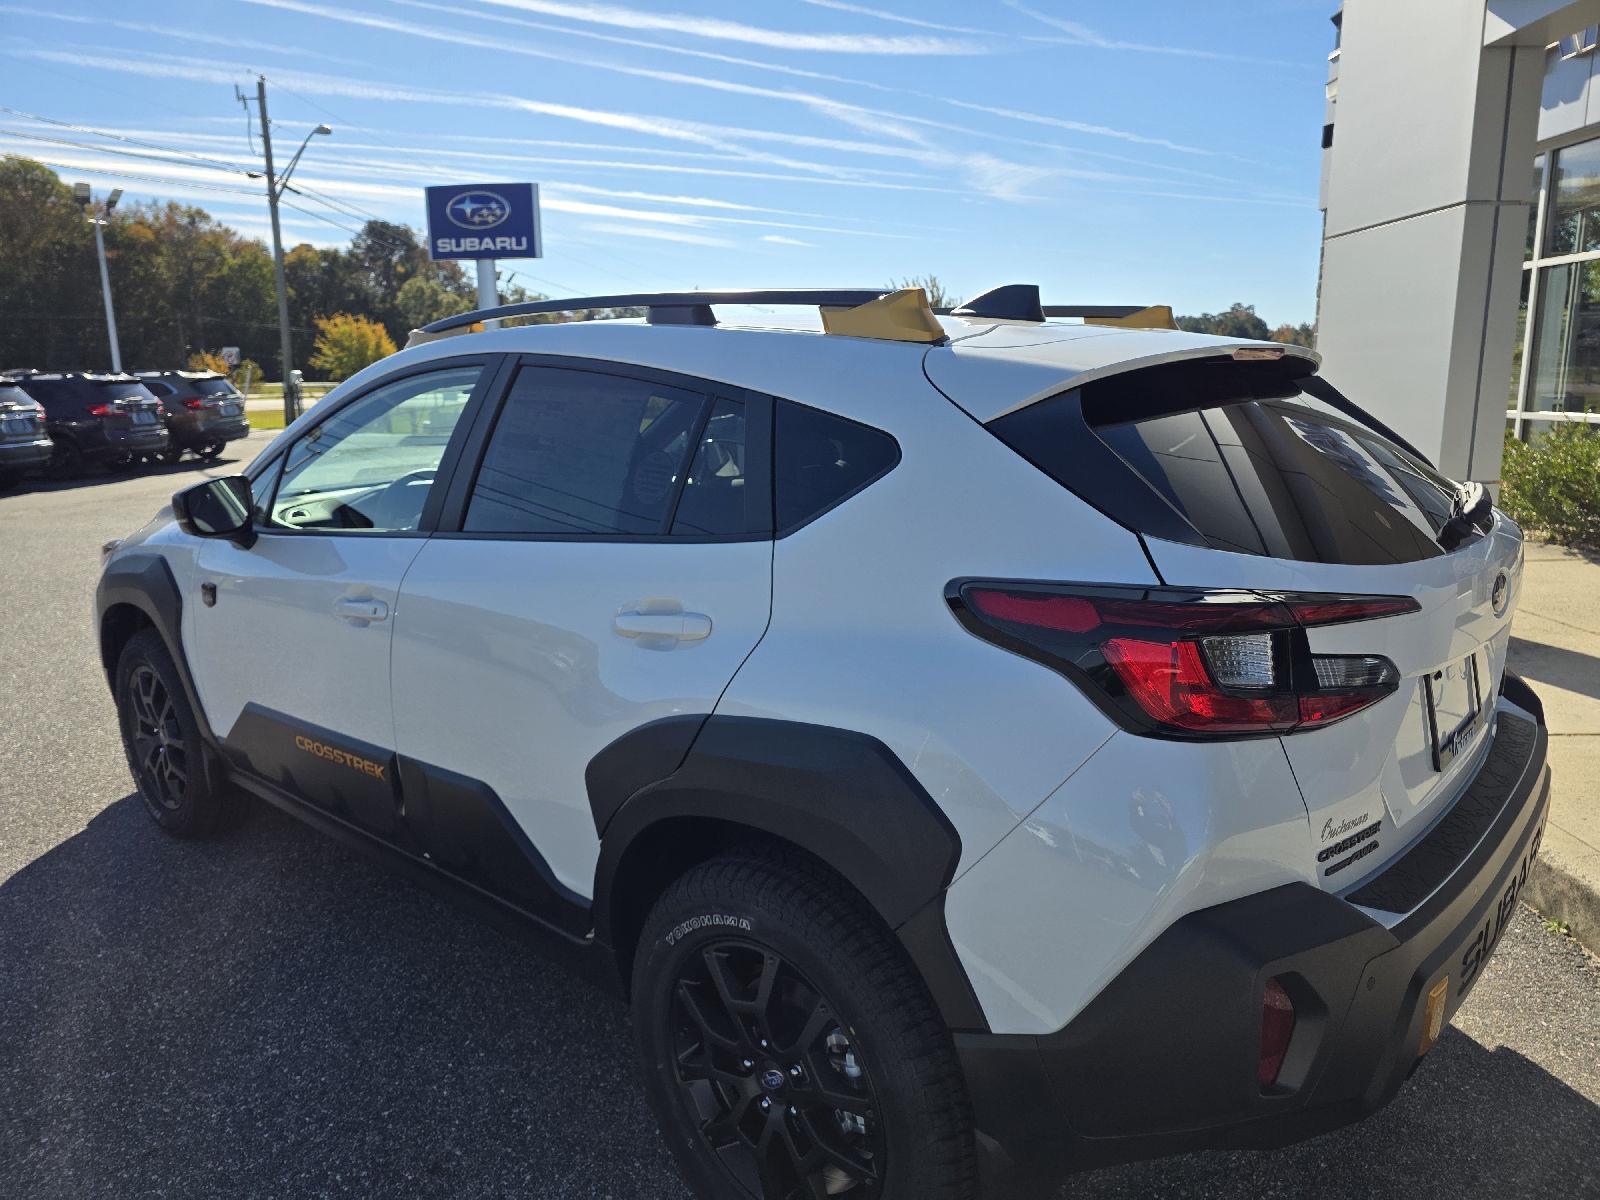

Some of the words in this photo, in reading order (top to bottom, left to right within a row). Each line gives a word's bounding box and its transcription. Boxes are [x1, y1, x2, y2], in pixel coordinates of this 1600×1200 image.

[437, 236, 527, 252] SUBARU
[295, 735, 385, 780] CROSSTREK
[1317, 820, 1382, 862] CROSSTREK
[665, 914, 751, 946] YOKOHAMA
